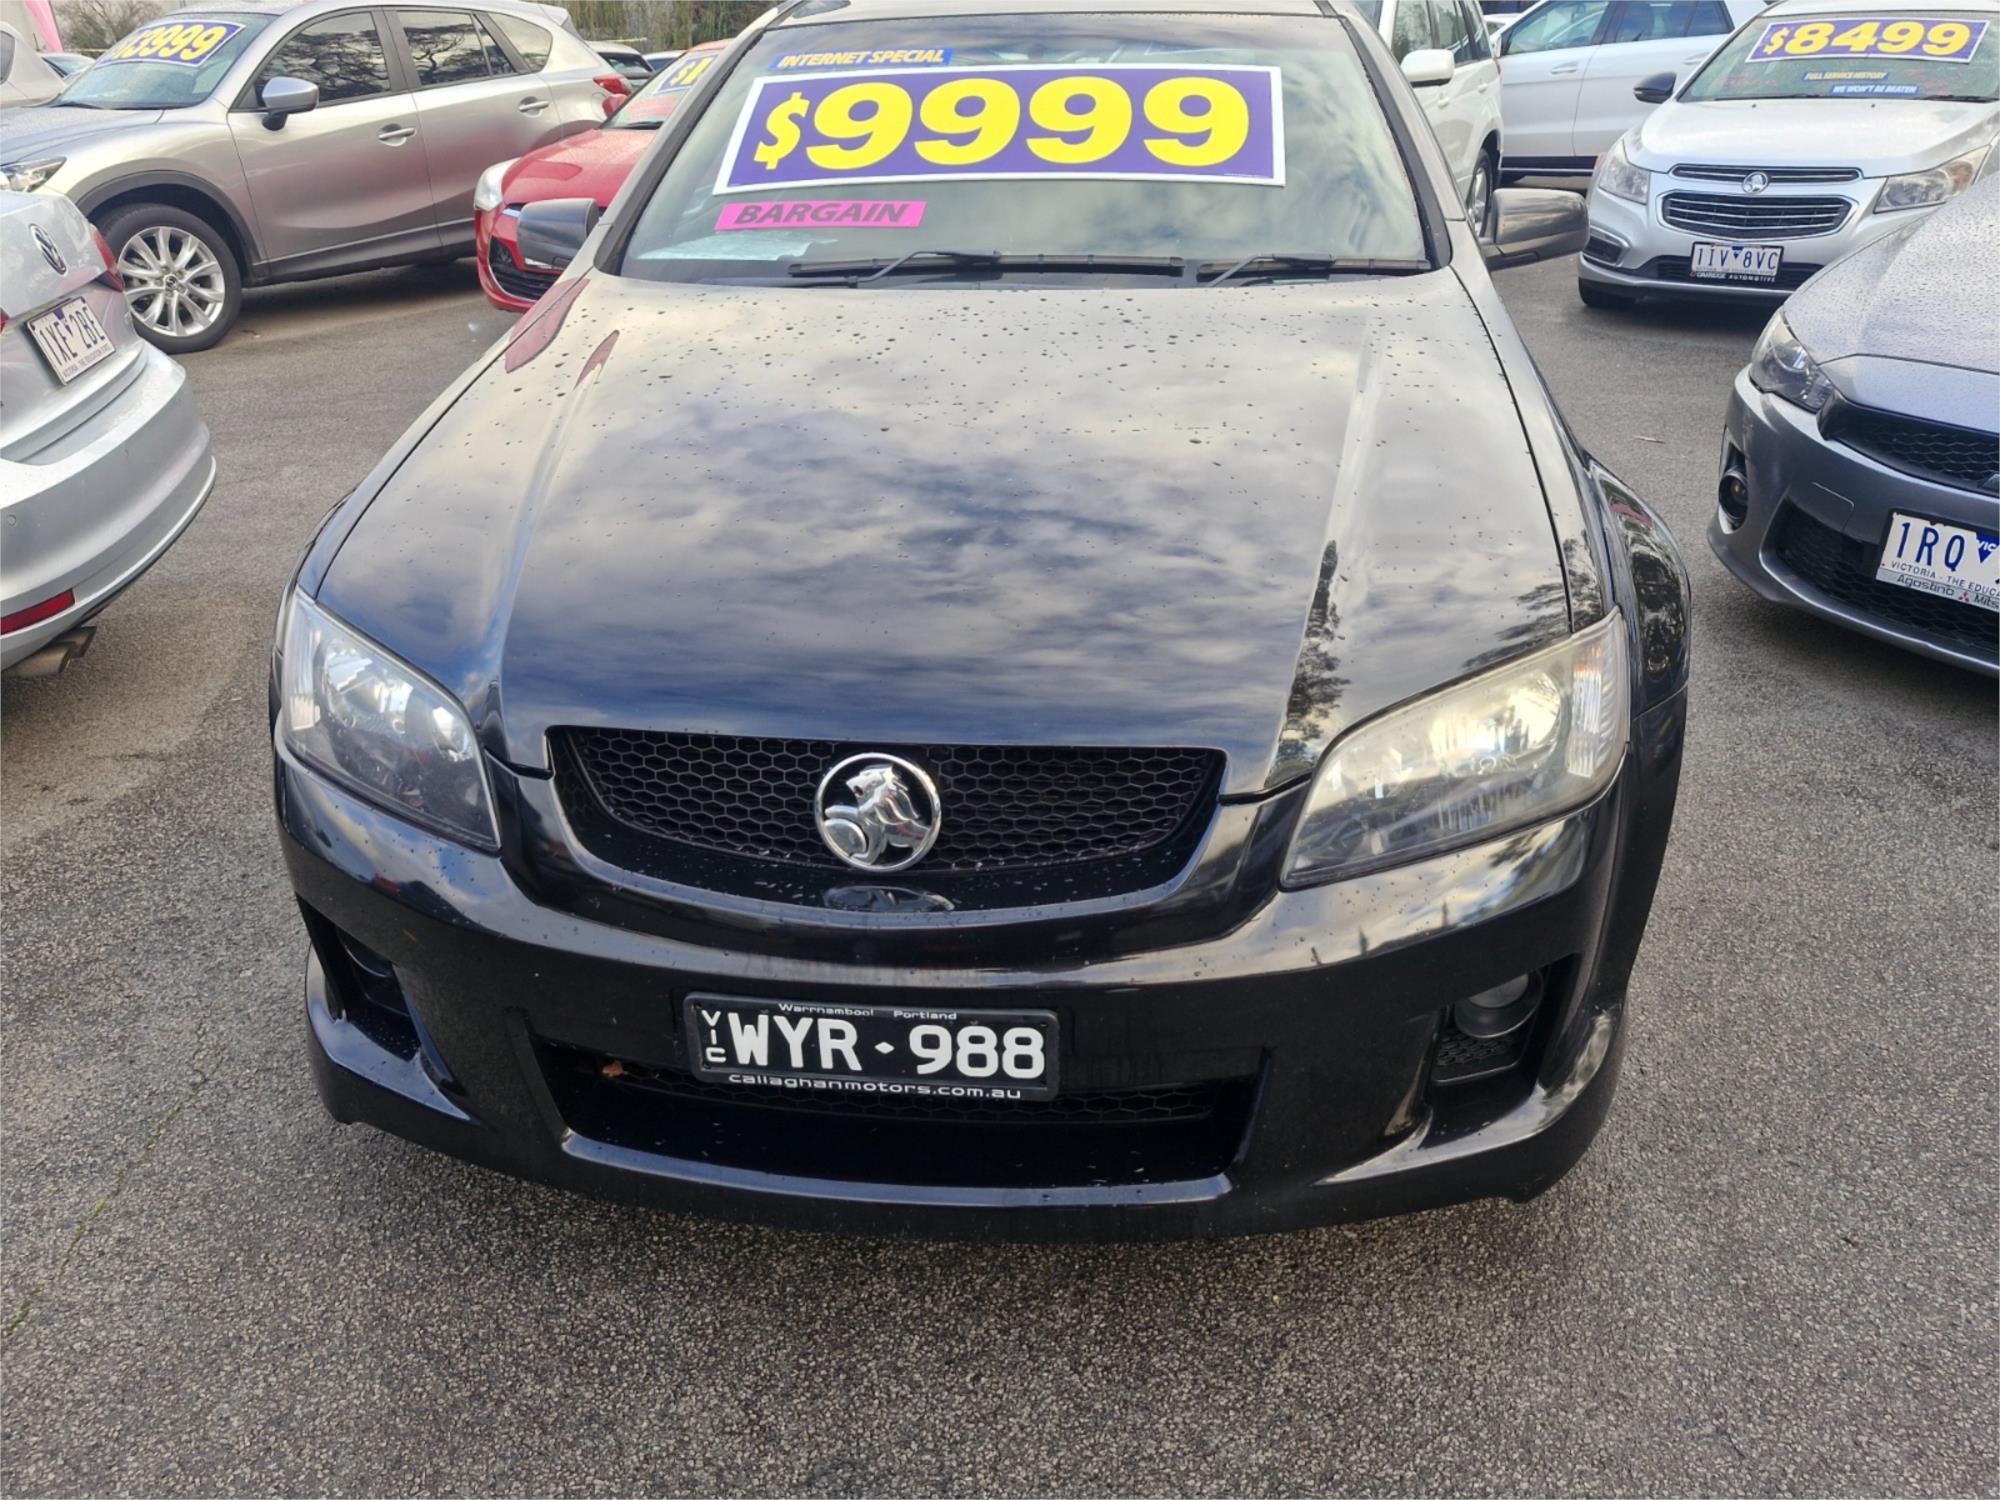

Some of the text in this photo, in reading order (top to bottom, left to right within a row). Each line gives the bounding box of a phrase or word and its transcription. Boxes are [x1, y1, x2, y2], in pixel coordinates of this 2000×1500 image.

[1764, 21, 1971, 55] $8499
[777, 50, 944, 68] INTERNET SPECIAL
[753, 76, 1249, 170] $9999
[735, 203, 909, 224] BARGAIN
[1743, 251, 1778, 269] 8VC
[39, 321, 78, 366] 1XE
[69, 306, 105, 348] 2BE
[1897, 522, 1965, 572] 1RQ
[1891, 561, 1936, 579] VICTORIA
[1947, 575, 1966, 588] THE
[1897, 574, 1955, 597] Agostino
[778, 1002, 957, 1021] Warrnambool Portland
[701, 1010, 728, 1064] VIC
[728, 1012, 1046, 1079] WYR 988
[729, 1073, 1021, 1099] callaghanmotors.com.au
